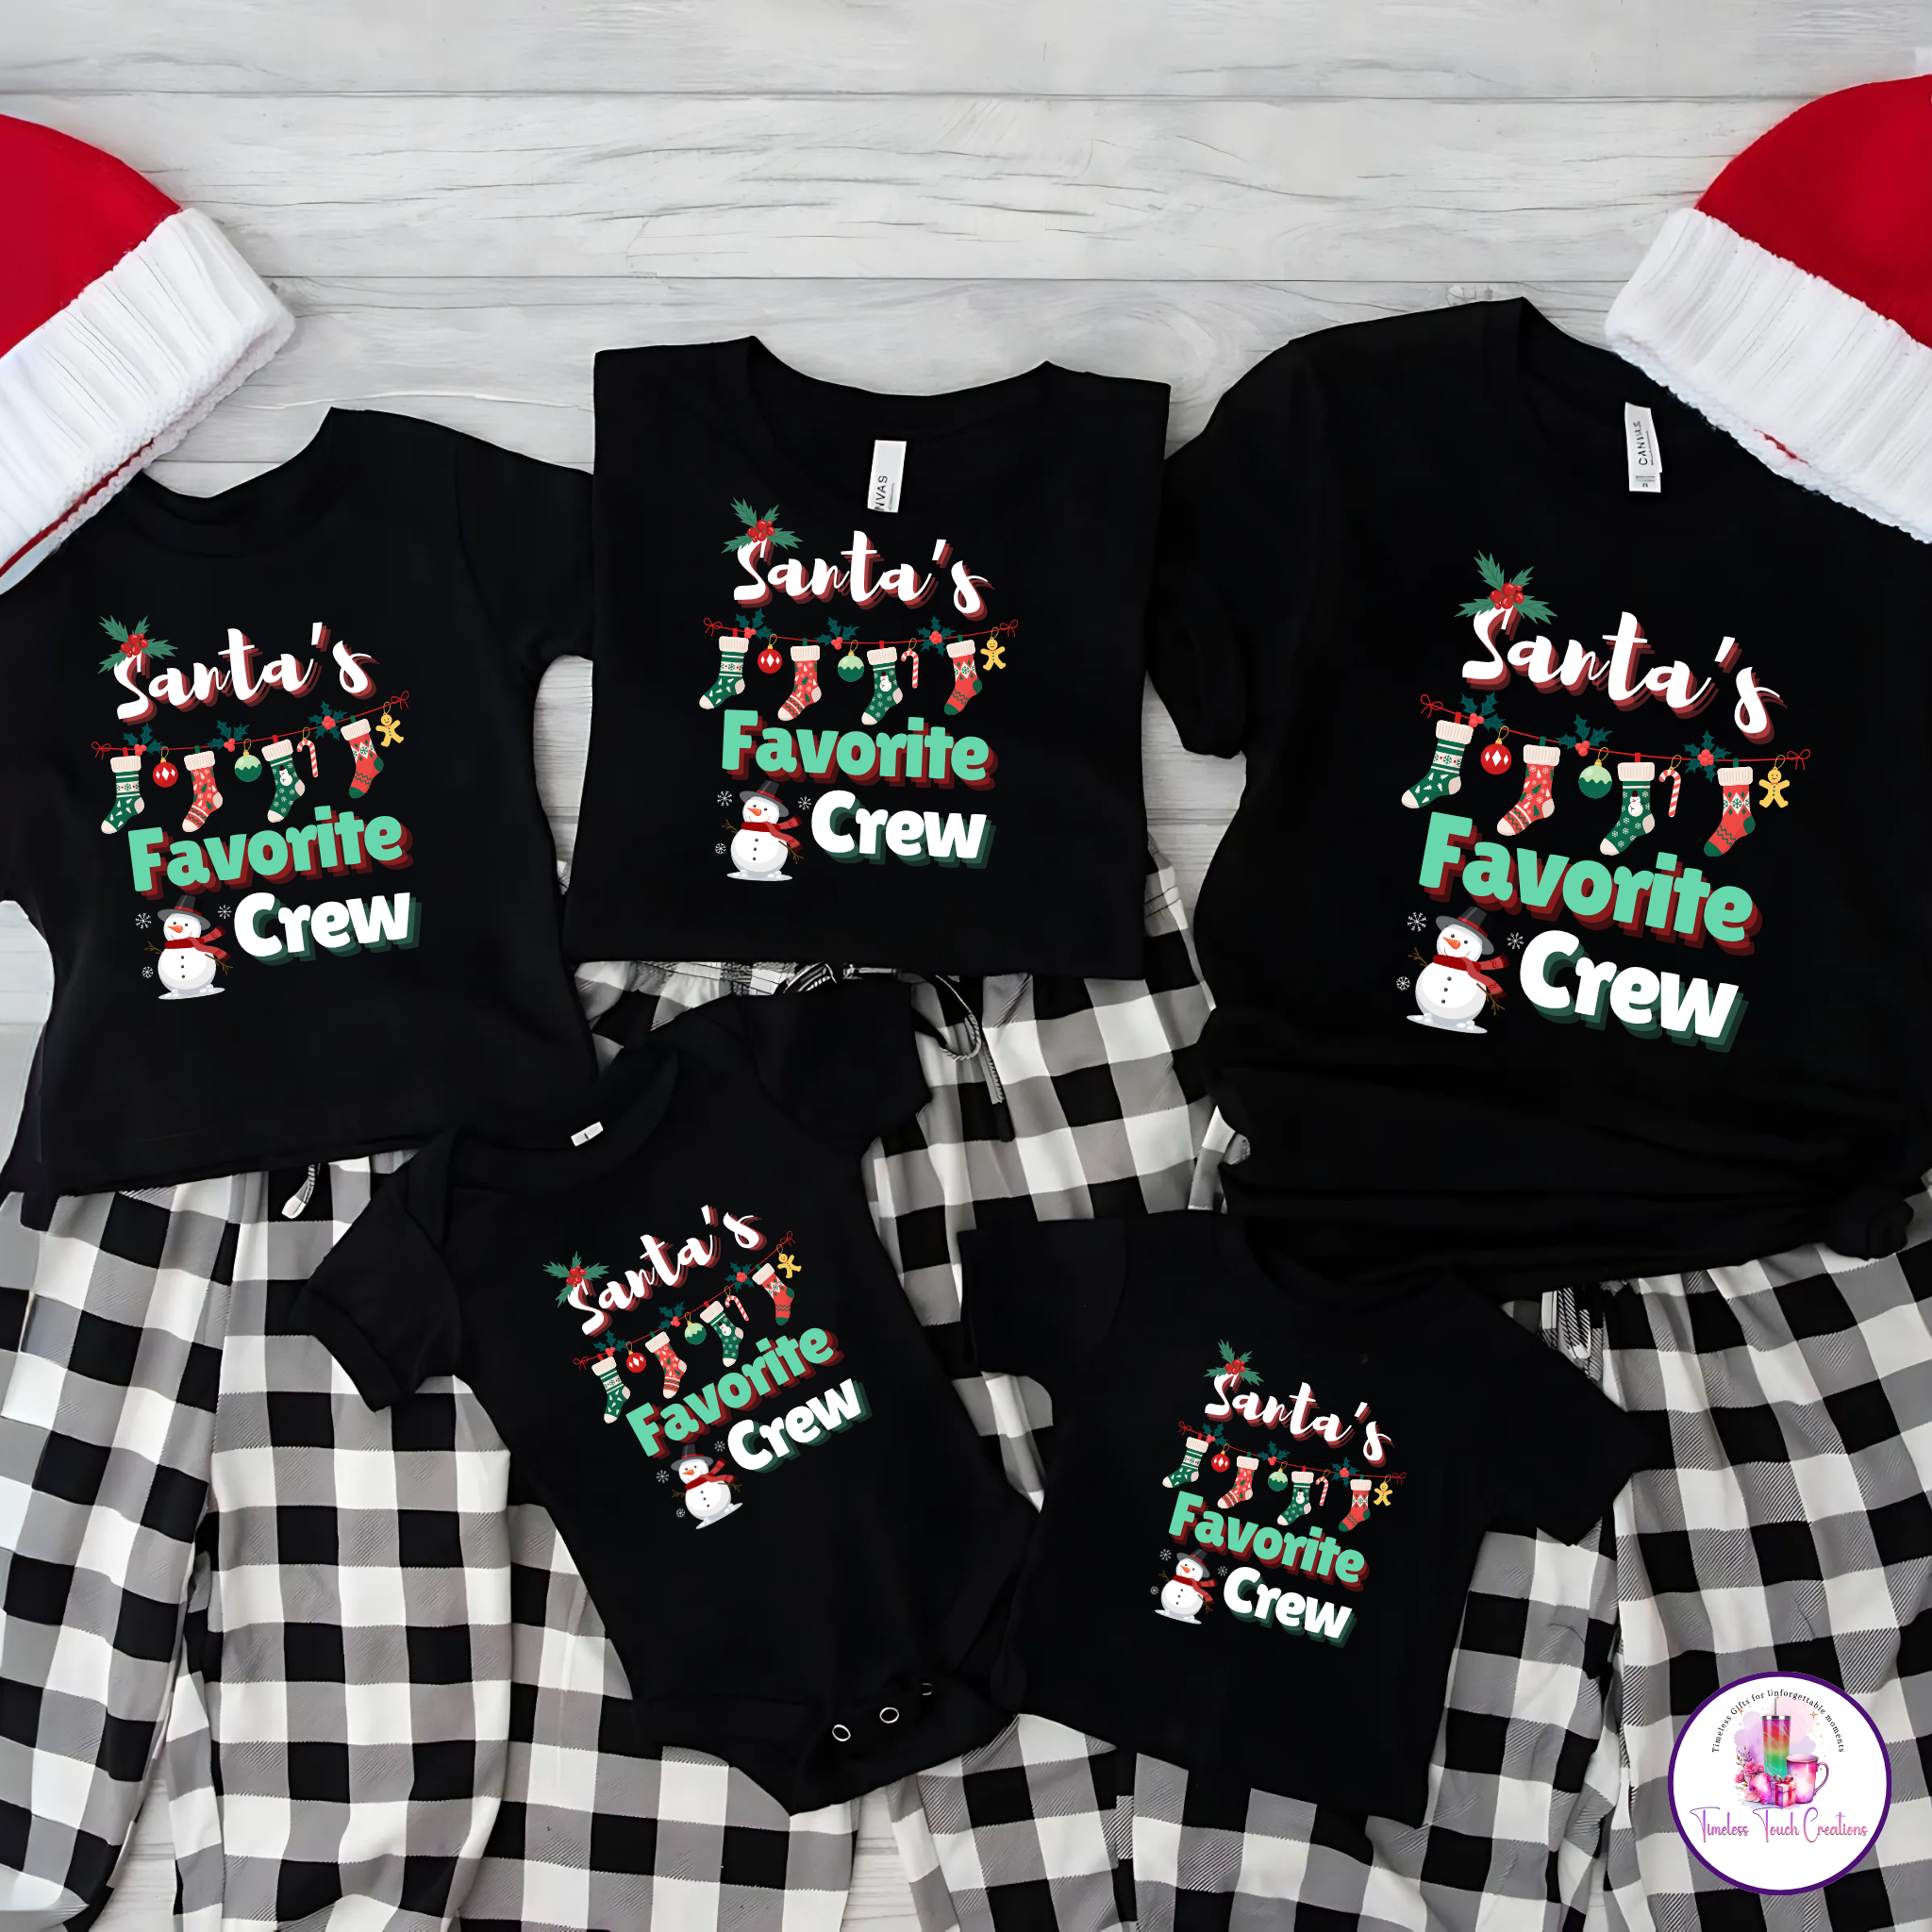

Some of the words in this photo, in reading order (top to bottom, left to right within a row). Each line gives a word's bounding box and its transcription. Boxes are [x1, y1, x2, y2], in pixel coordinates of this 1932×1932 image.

[733, 531, 992, 618] Santa's
[114, 622, 376, 722] Santa's
[1462, 607, 1784, 740] Santa's
[722, 709, 994, 787] Favorite
[128, 806, 408, 896] Favorite
[811, 790, 991, 864] Crew
[234, 892, 416, 961] Crew
[1419, 811, 1758, 949] Favorite
[1520, 929, 1744, 1045] Crew
[568, 1205, 763, 1335] Santa's
[625, 1327, 840, 1457] Favorite
[727, 1378, 867, 1472] Crew
[1205, 1374, 1393, 1464] Santa's
[1168, 1491, 1368, 1587] Favorite
[1224, 1566, 1355, 1643] Crew
